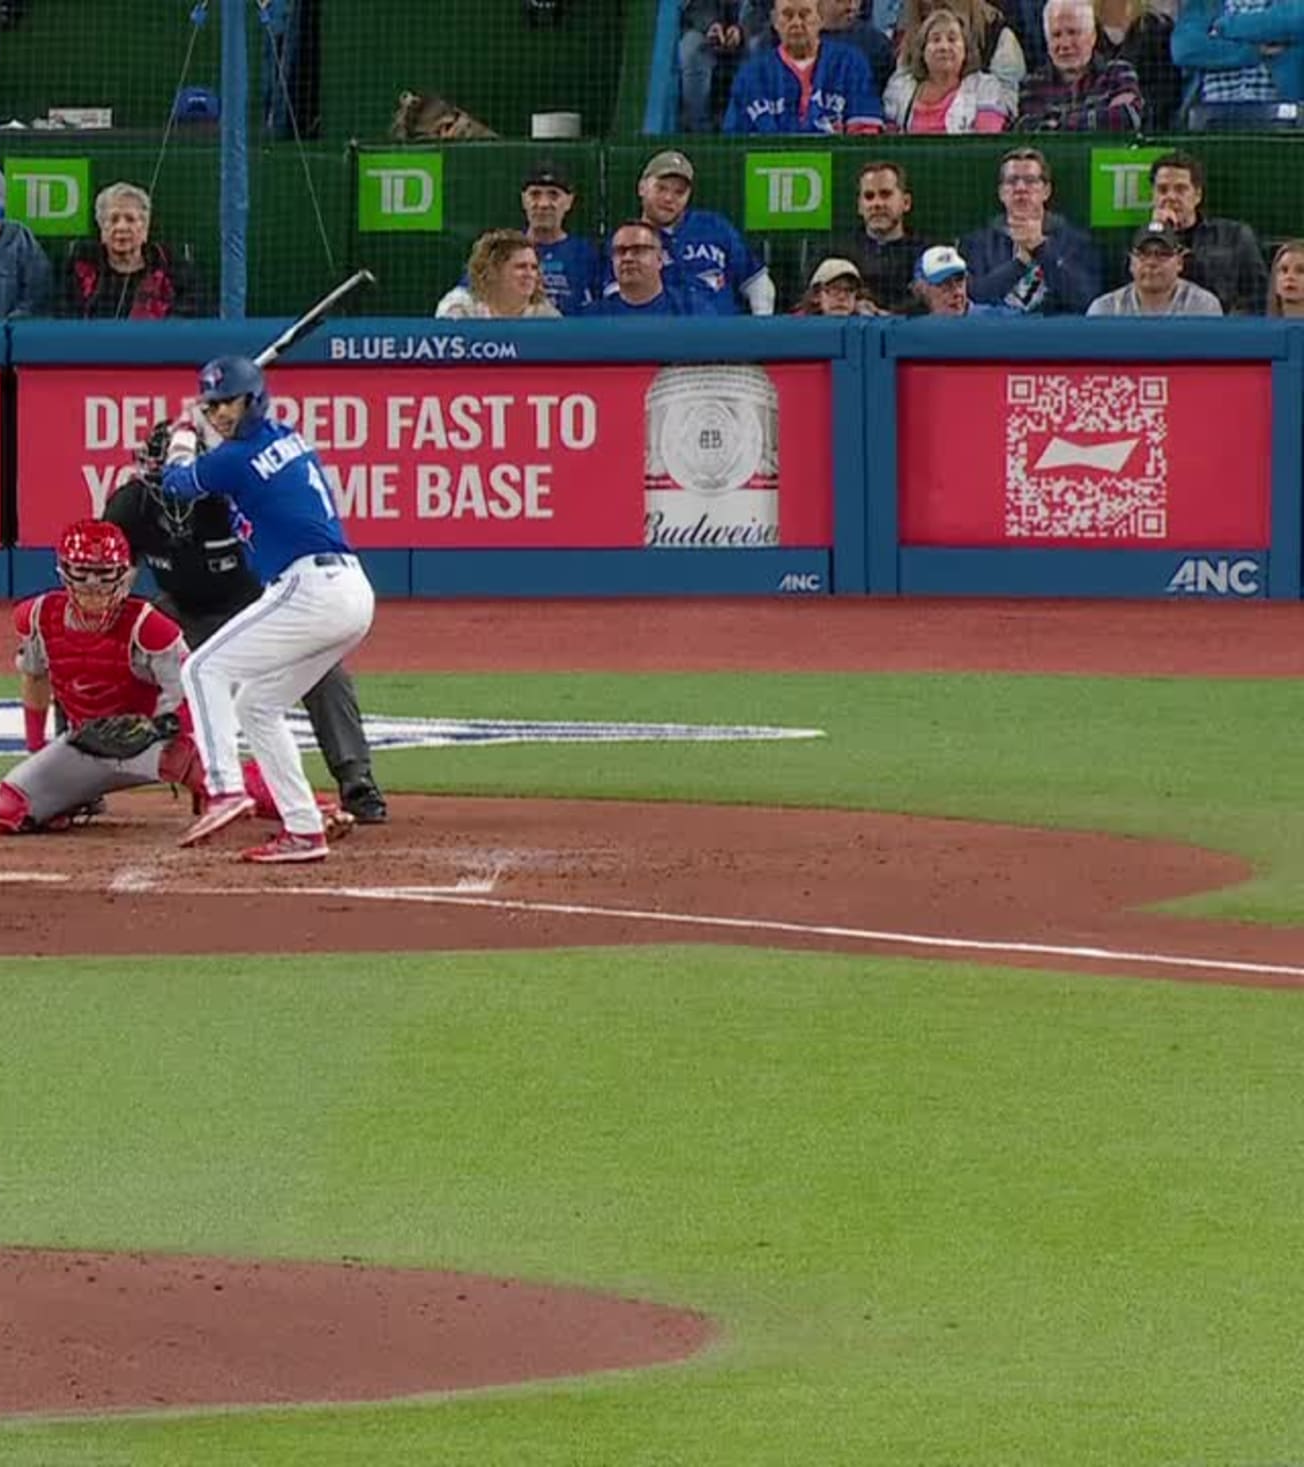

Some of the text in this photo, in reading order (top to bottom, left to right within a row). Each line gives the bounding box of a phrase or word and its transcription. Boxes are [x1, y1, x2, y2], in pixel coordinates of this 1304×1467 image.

[12, 173, 81, 219] TD
[366, 169, 434, 214] TD
[755, 167, 824, 213] TD
[387, 396, 515, 450] FAST
[527, 395, 597, 450] TO
[417, 464, 554, 519] BASE
[779, 573, 821, 592] ANC
[1166, 560, 1259, 594] ANC
